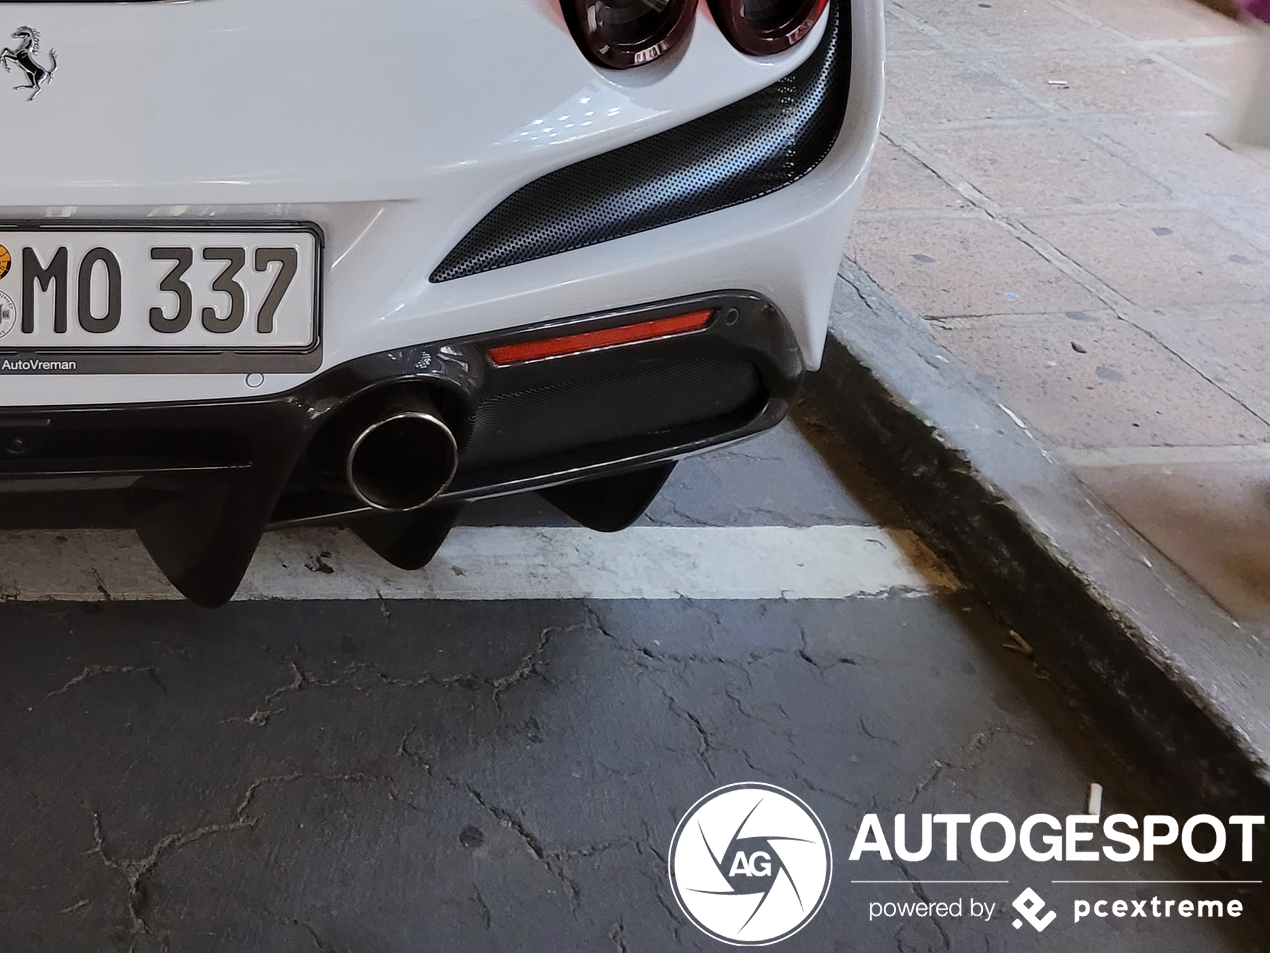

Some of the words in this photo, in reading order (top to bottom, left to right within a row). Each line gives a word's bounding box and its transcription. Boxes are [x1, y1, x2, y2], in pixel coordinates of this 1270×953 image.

[21, 246, 122, 334] MO
[149, 246, 298, 334] 337
[1, 359, 77, 370] AutoVreman
